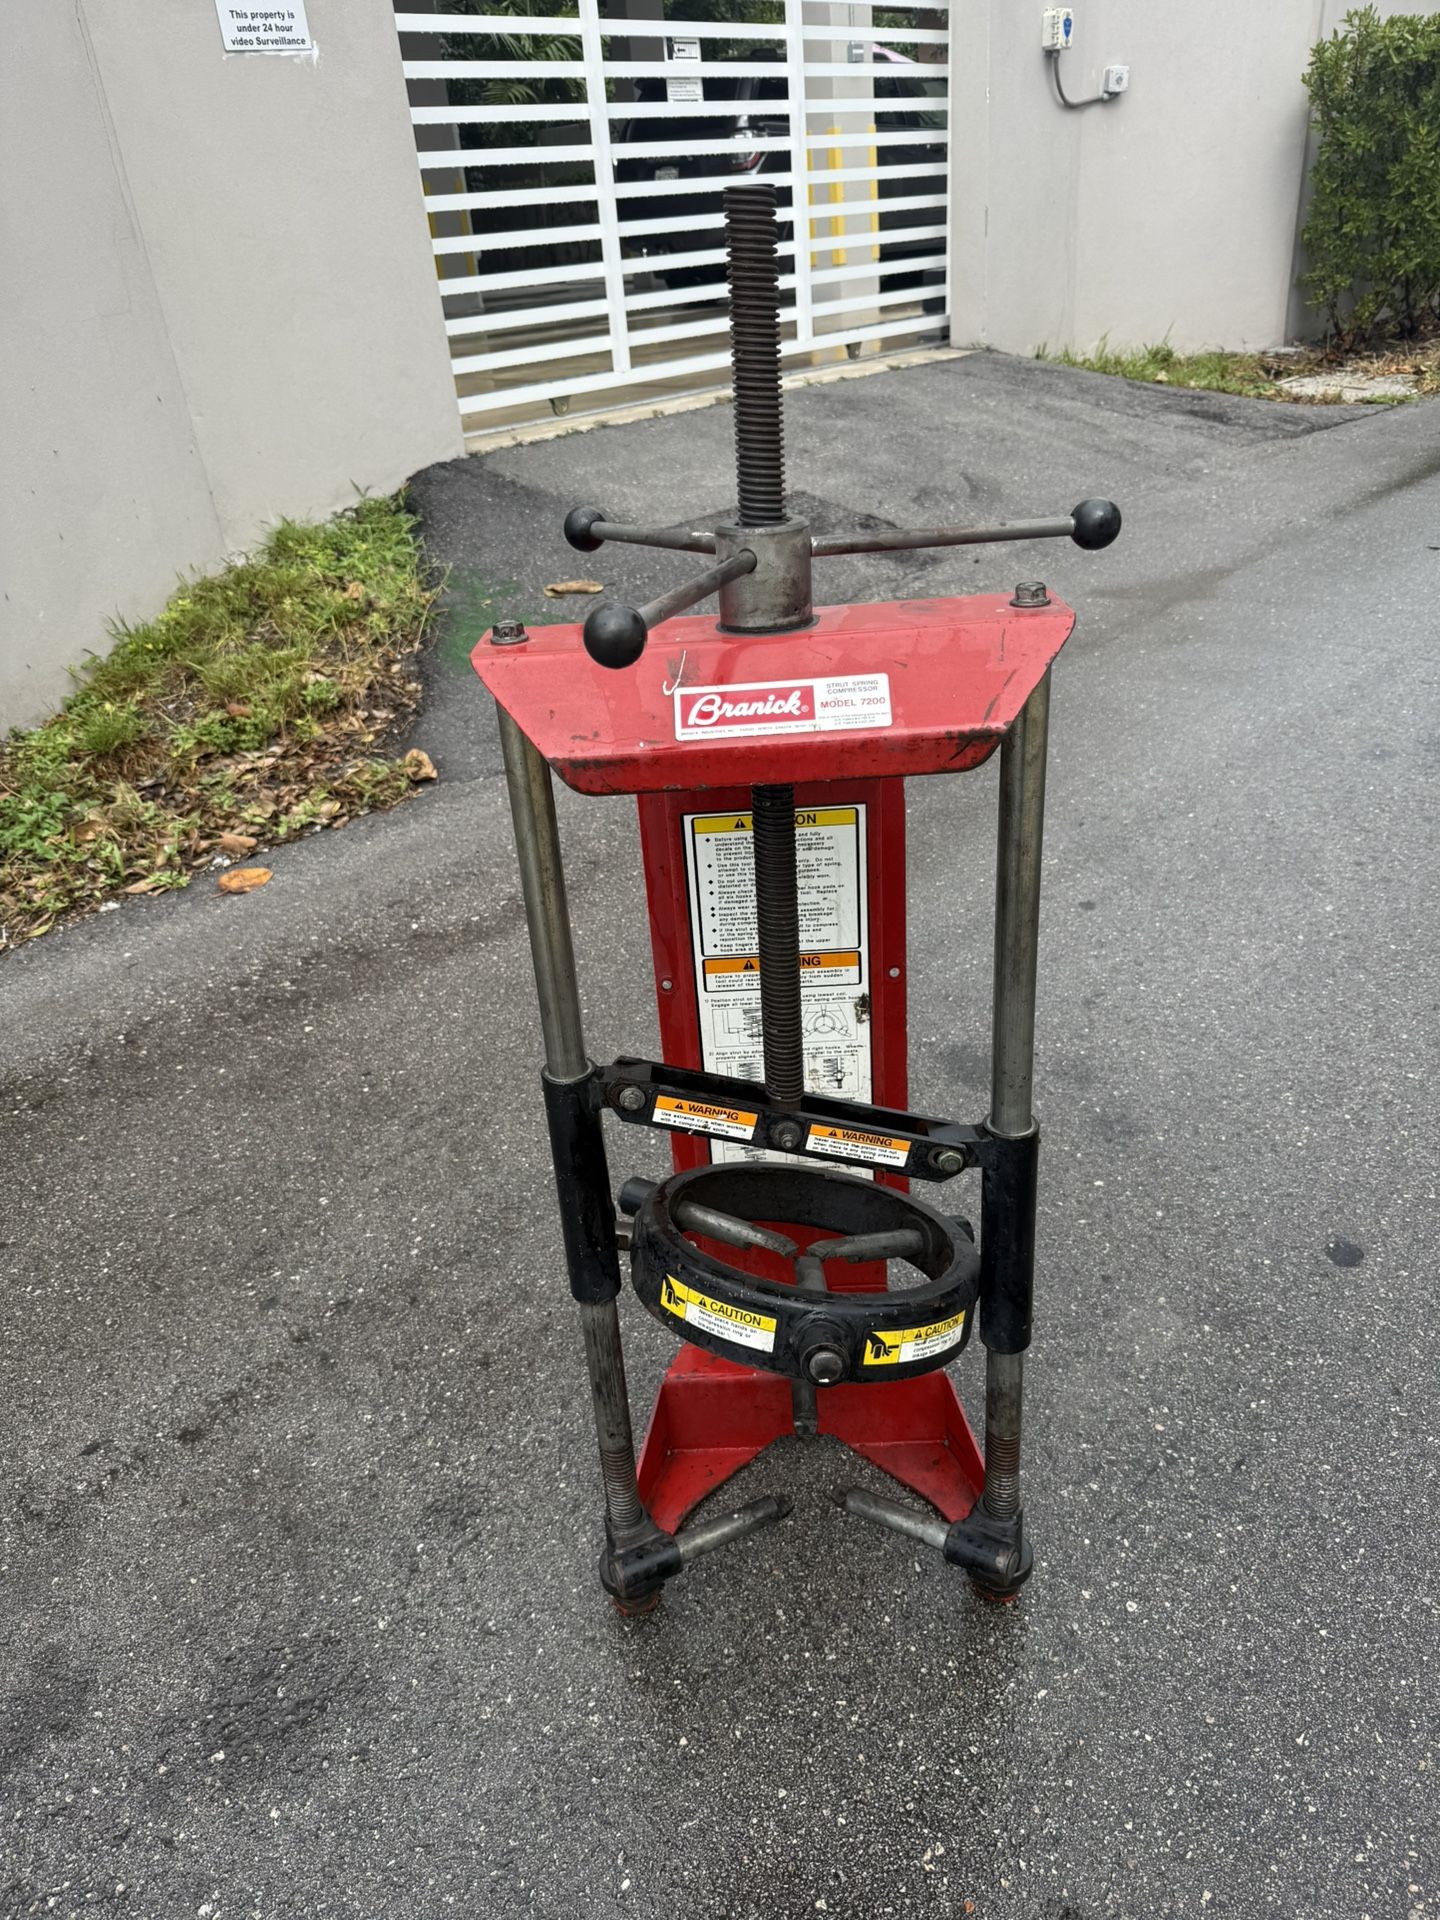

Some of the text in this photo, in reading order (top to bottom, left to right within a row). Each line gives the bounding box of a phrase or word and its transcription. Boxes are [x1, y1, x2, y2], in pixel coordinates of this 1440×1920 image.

[229, 10, 295, 21] This property is
[237, 23, 293, 32] under 24 hour
[231, 36, 306, 46] video Surveillance
[827, 686, 878, 695] COMPRESSOR
[687, 690, 801, 726] Branick
[820, 697, 886, 709] MODEL 7200
[688, 1104, 739, 1120] WARNING
[842, 1131, 893, 1147] WARNING
[710, 1301, 762, 1327] CAUTION
[925, 1316, 960, 1337] CAUTION
